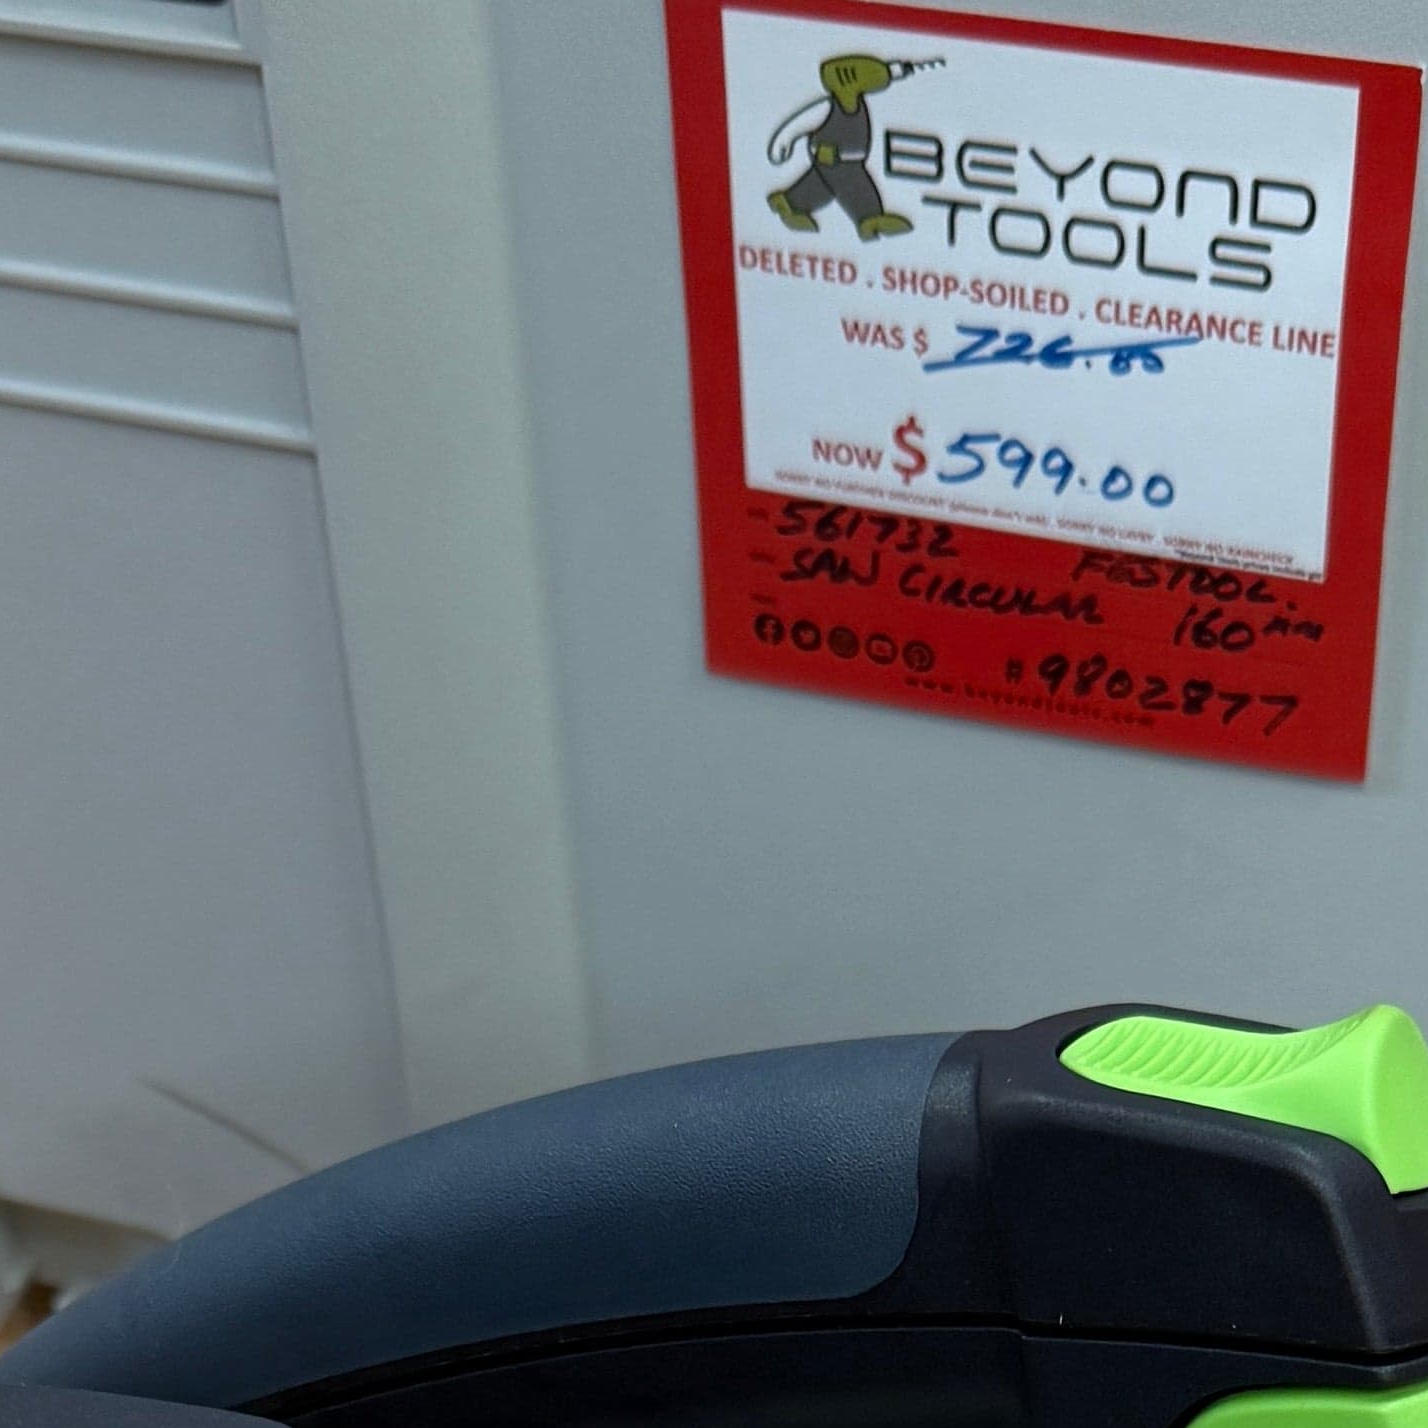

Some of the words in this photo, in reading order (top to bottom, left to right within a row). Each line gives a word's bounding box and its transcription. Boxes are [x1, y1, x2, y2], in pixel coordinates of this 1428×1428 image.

[884, 128, 1317, 234] BEYOND
[921, 195, 1273, 293] TOOLS
[738, 245, 858, 285] DELETED
[882, 264, 1071, 317] SHOP-SOILED
[1094, 297, 1265, 347] CLEARANCE
[1272, 322, 1337, 358] LINE
[841, 317, 906, 352] WAS
[811, 438, 884, 473] NOW
[936, 432, 1176, 509] 599.00
[776, 498, 959, 558] 561732
[780, 547, 880, 587] SAW
